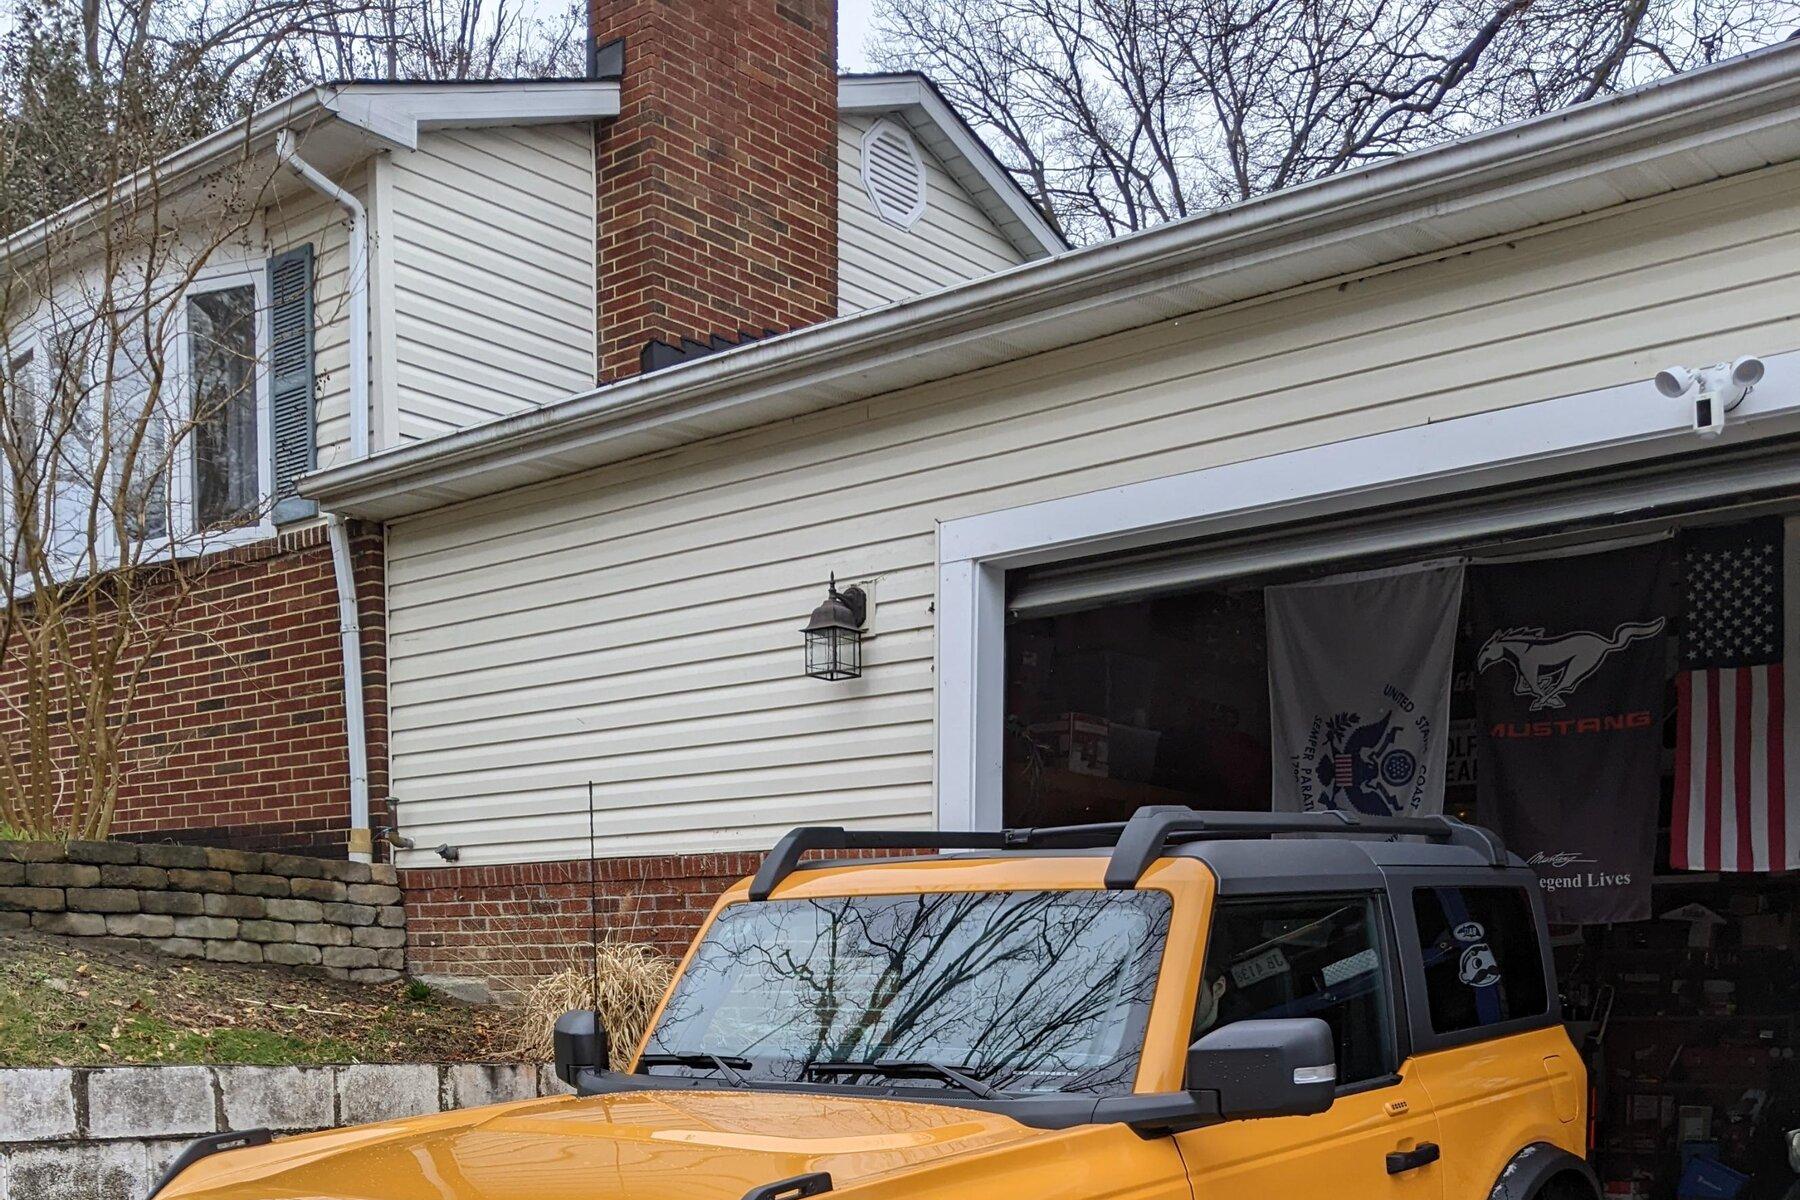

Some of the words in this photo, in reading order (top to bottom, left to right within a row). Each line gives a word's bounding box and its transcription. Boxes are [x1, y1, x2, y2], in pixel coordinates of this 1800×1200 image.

[1302, 714, 1323, 761] SEMPER
[1383, 683, 1415, 713] UNITED
[1411, 765, 1427, 810] COAST
[1539, 873, 1582, 892] egend
[1587, 872, 1632, 887] Lives
